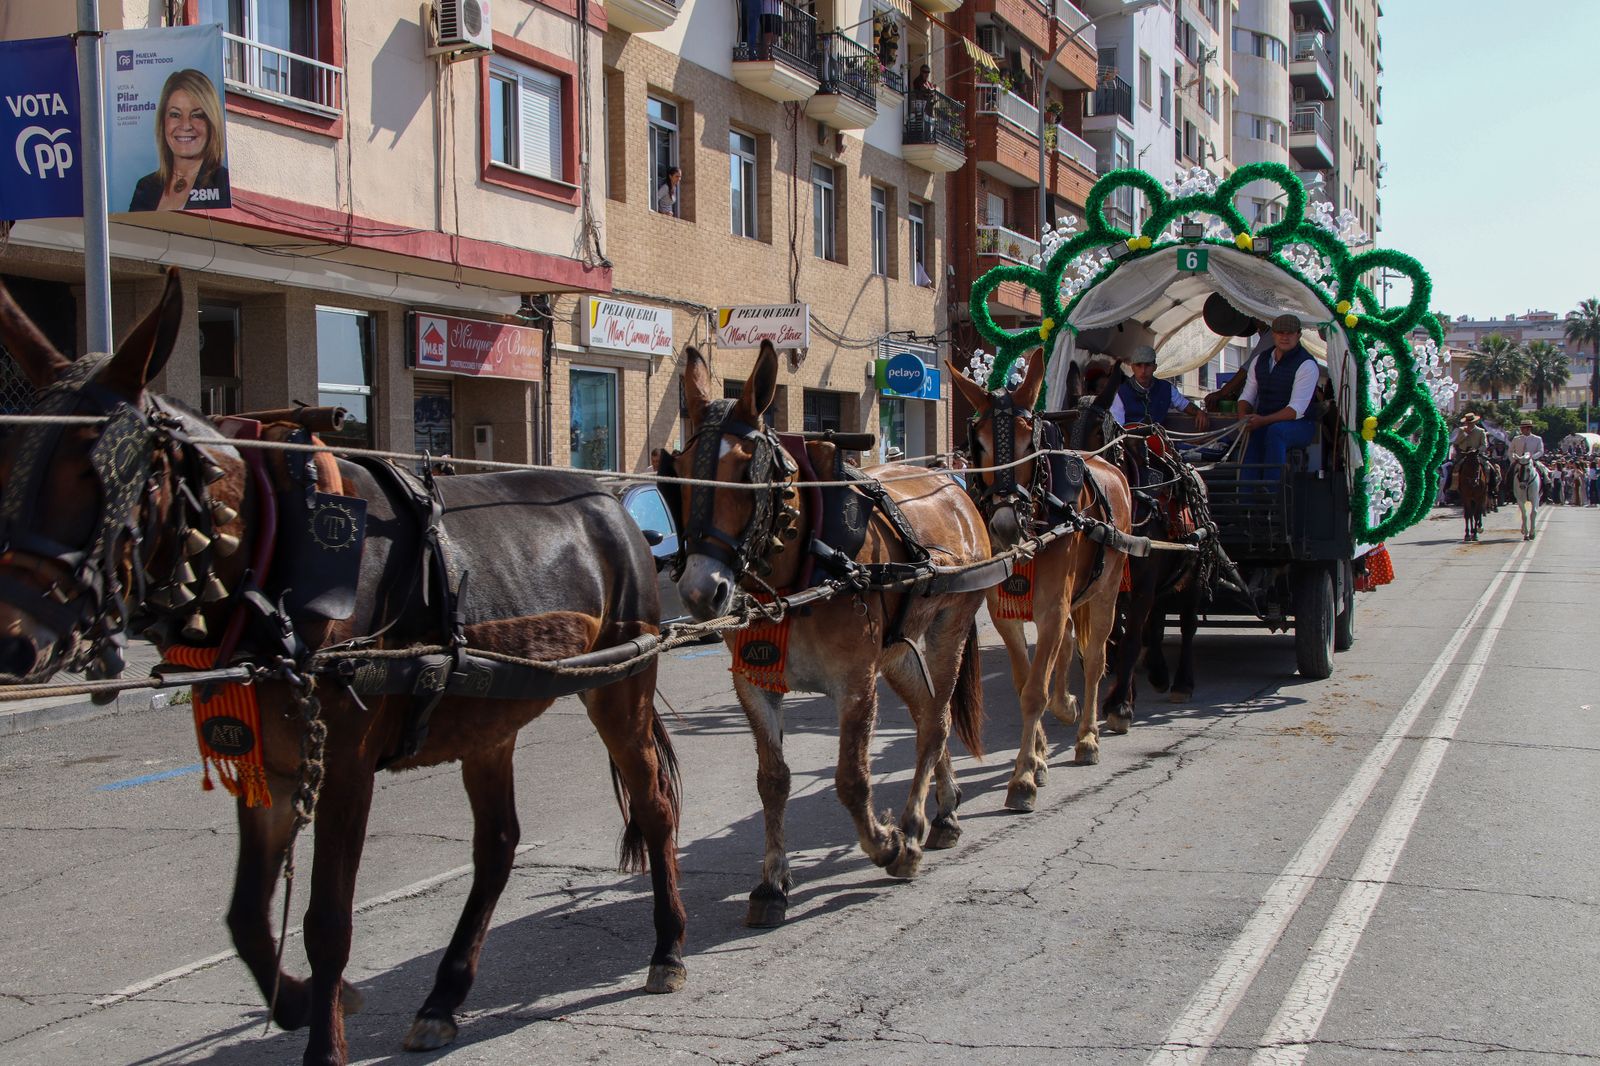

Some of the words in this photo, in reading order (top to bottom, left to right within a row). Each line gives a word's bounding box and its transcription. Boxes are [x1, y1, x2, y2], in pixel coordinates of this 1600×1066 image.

[117, 92, 139, 102] Pilar
[6, 93, 68, 118] VOTA
[117, 102, 156, 113] Miranda
[190, 188, 220, 201] 28M
[1186, 252, 1198, 269] 6
[604, 316, 626, 346] Mari
[625, 320, 650, 346] Carmen
[724, 325, 748, 346] Mari
[747, 325, 776, 344] Carmen
[424, 341, 444, 355] M&B
[888, 368, 920, 379] pelayo
